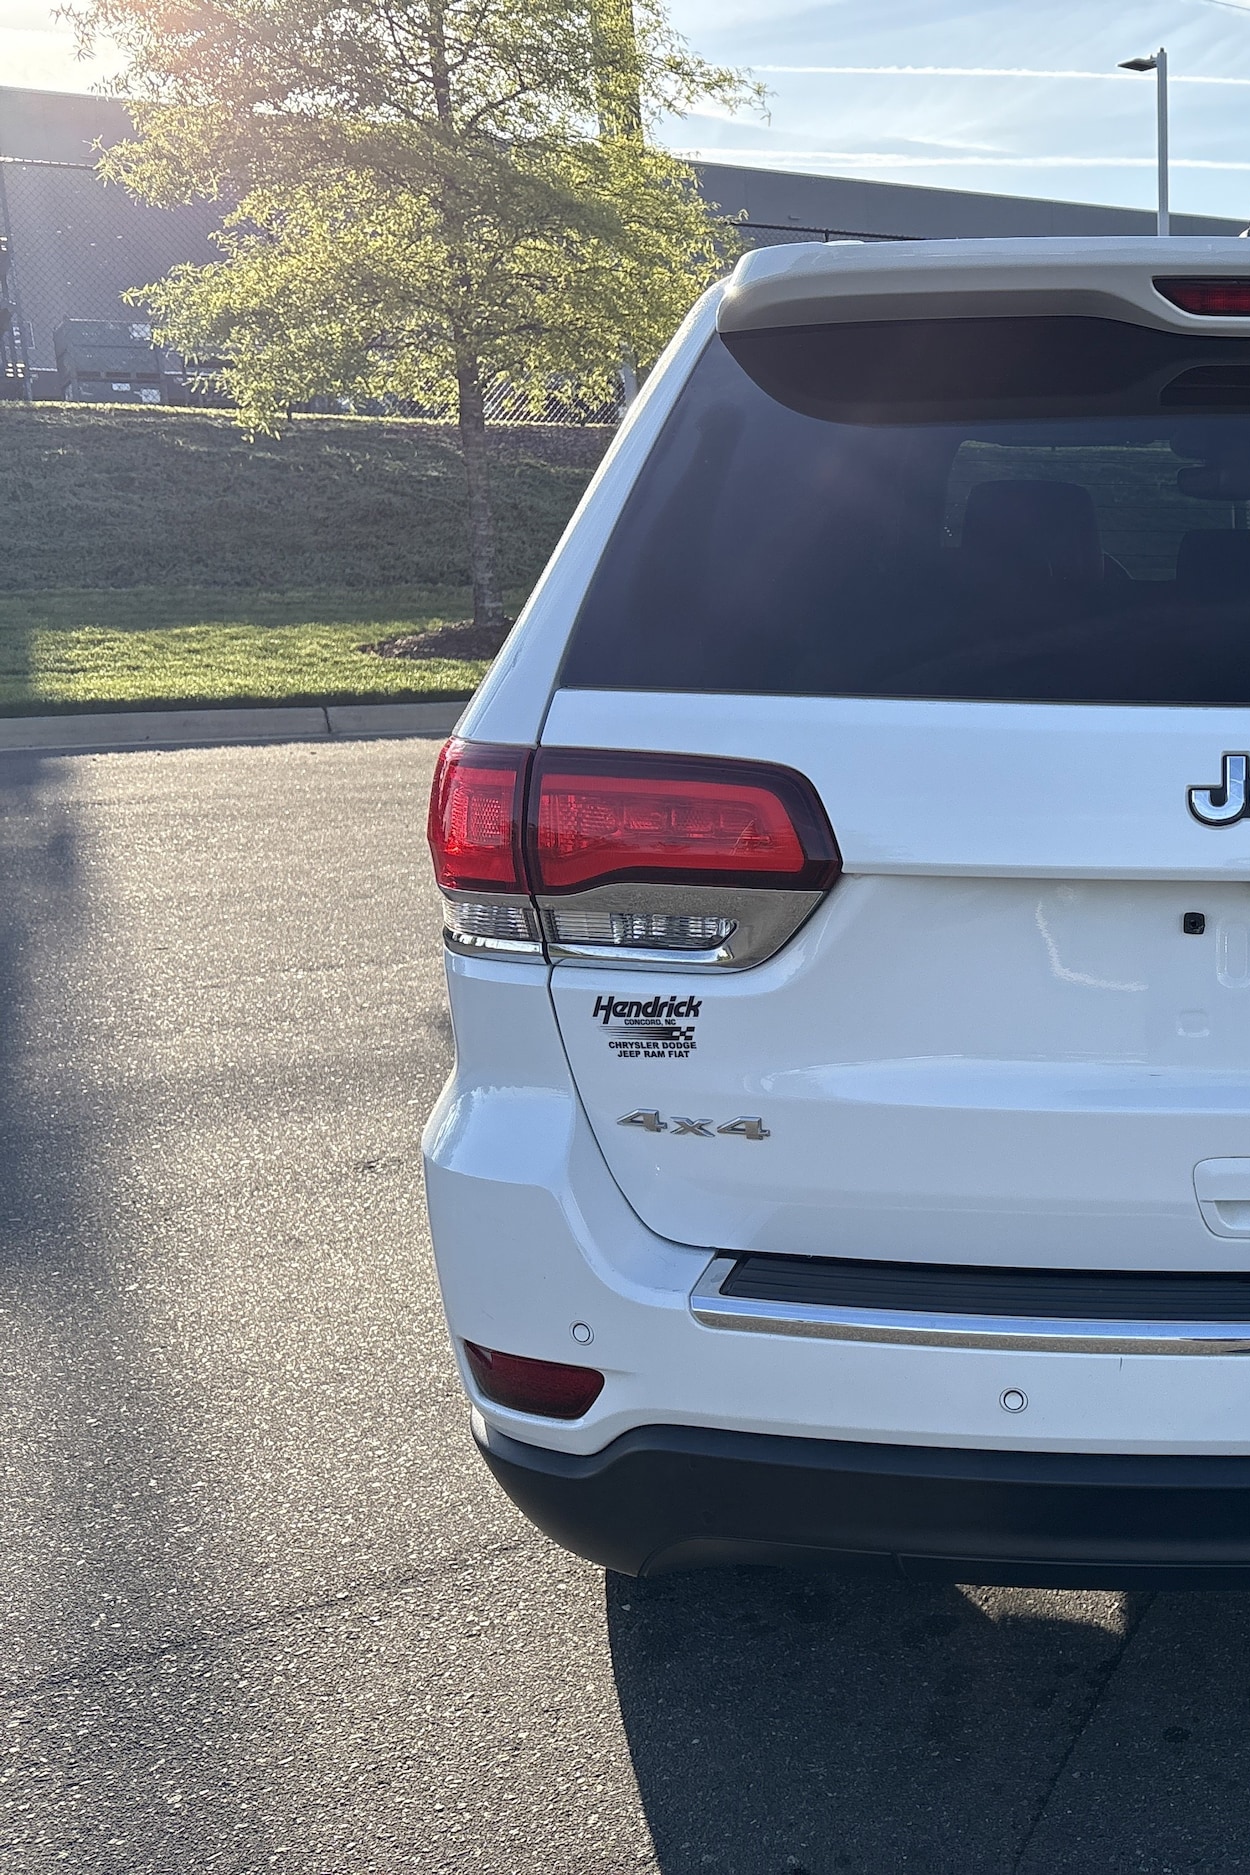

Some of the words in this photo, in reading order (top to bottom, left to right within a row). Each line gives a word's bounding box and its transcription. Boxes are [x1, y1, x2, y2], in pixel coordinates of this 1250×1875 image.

[592, 996, 702, 1024] Hendrick
[624, 1018, 663, 1026] CONCORD,
[609, 1041, 659, 1049] CHRYSLER
[617, 1050, 641, 1058] JEEP
[643, 1050, 666, 1058] RAM
[668, 1050, 690, 1058] FIAT
[616, 1108, 771, 1140] 4x4
